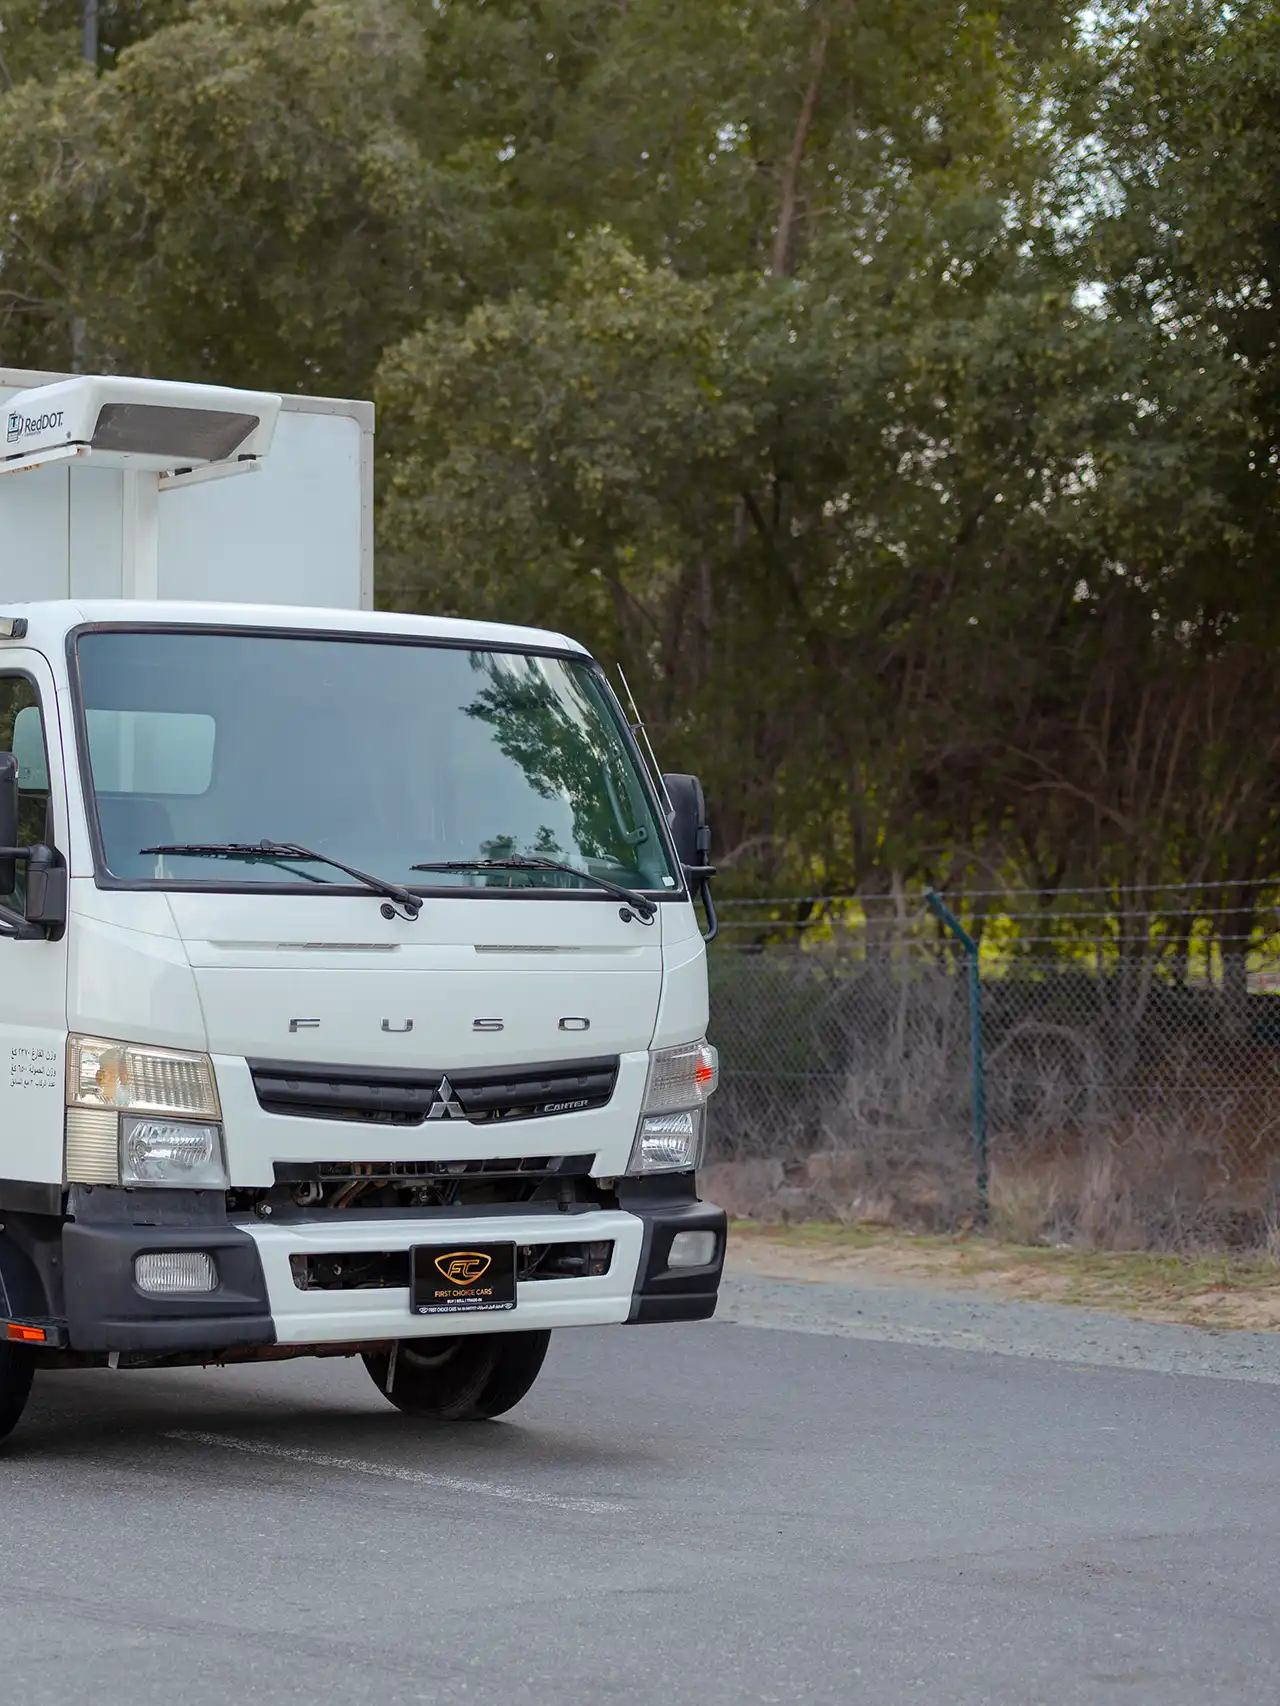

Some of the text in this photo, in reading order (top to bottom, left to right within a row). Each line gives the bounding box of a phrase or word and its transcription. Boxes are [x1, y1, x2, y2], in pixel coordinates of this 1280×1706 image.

[288, 1017, 591, 1033] FUSO
[543, 1099, 589, 1113] CANTER
[434, 1288, 493, 1298] FIRST CHOICE CARS
